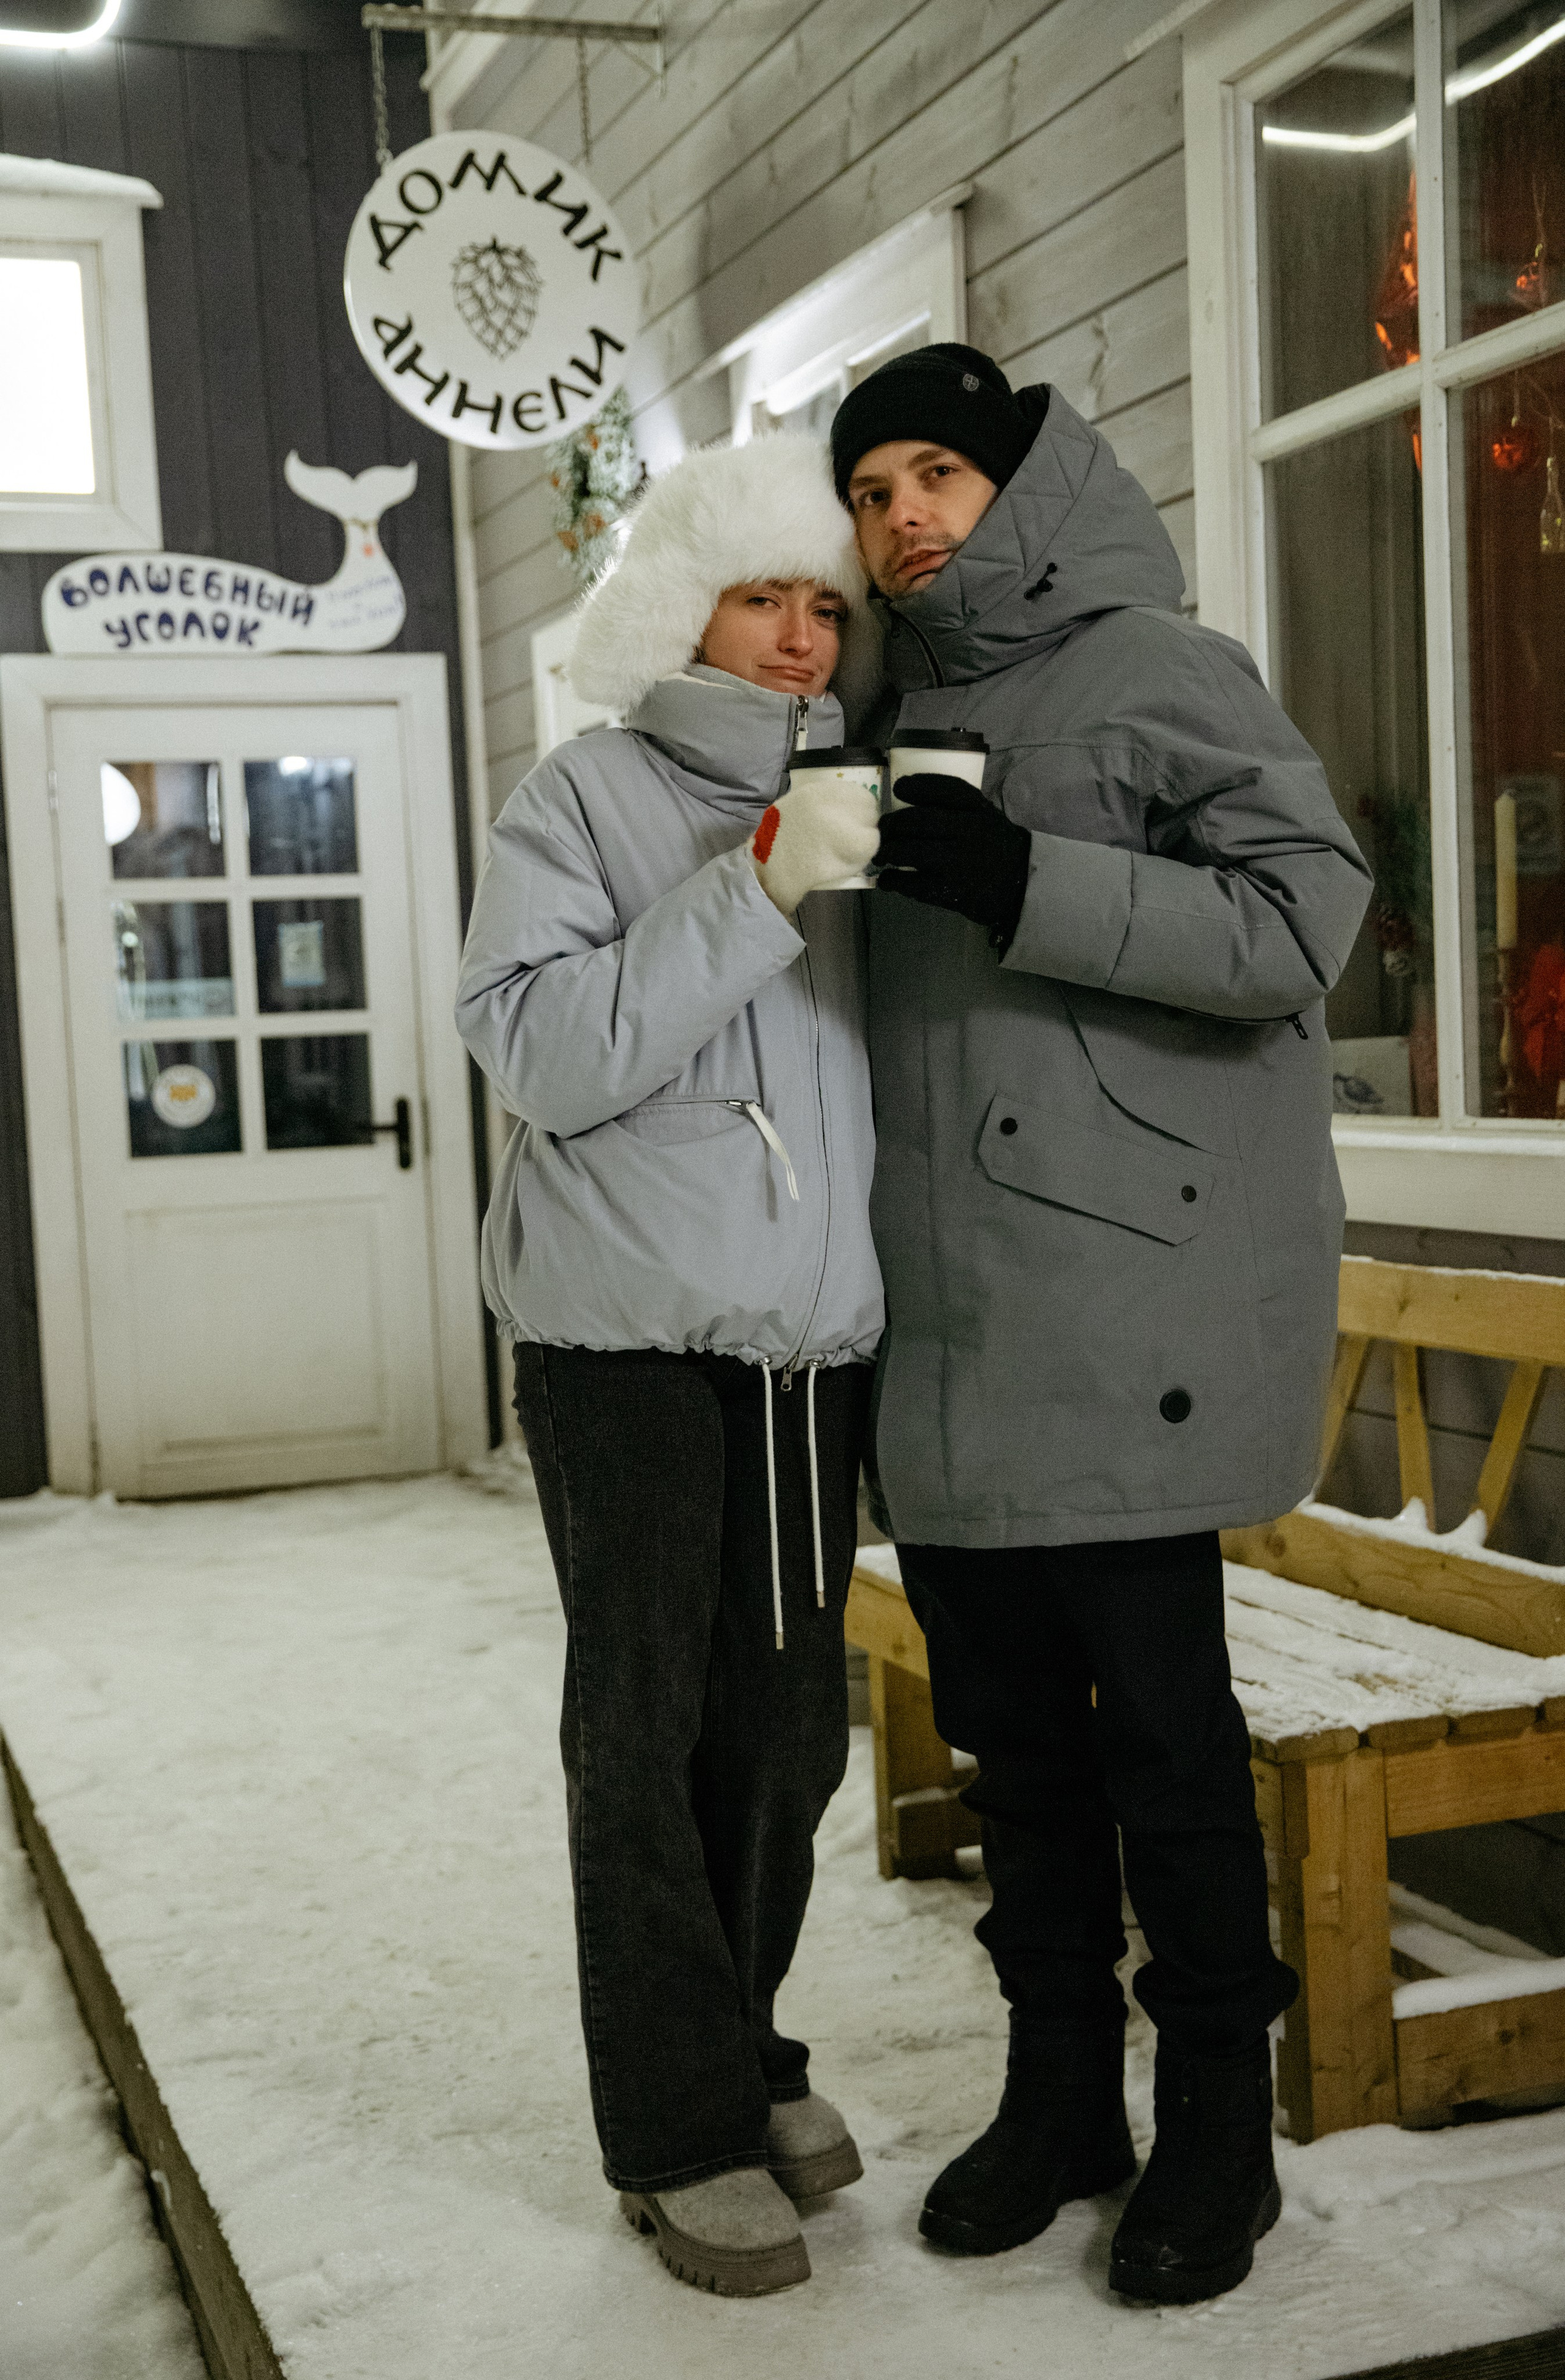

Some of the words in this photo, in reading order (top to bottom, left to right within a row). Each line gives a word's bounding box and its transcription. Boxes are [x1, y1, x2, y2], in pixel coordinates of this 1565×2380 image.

[369, 150, 622, 282] ДОМИК
[373, 316, 625, 434] АННЕЛИ
[105, 611, 261, 648] УГОЛОК
